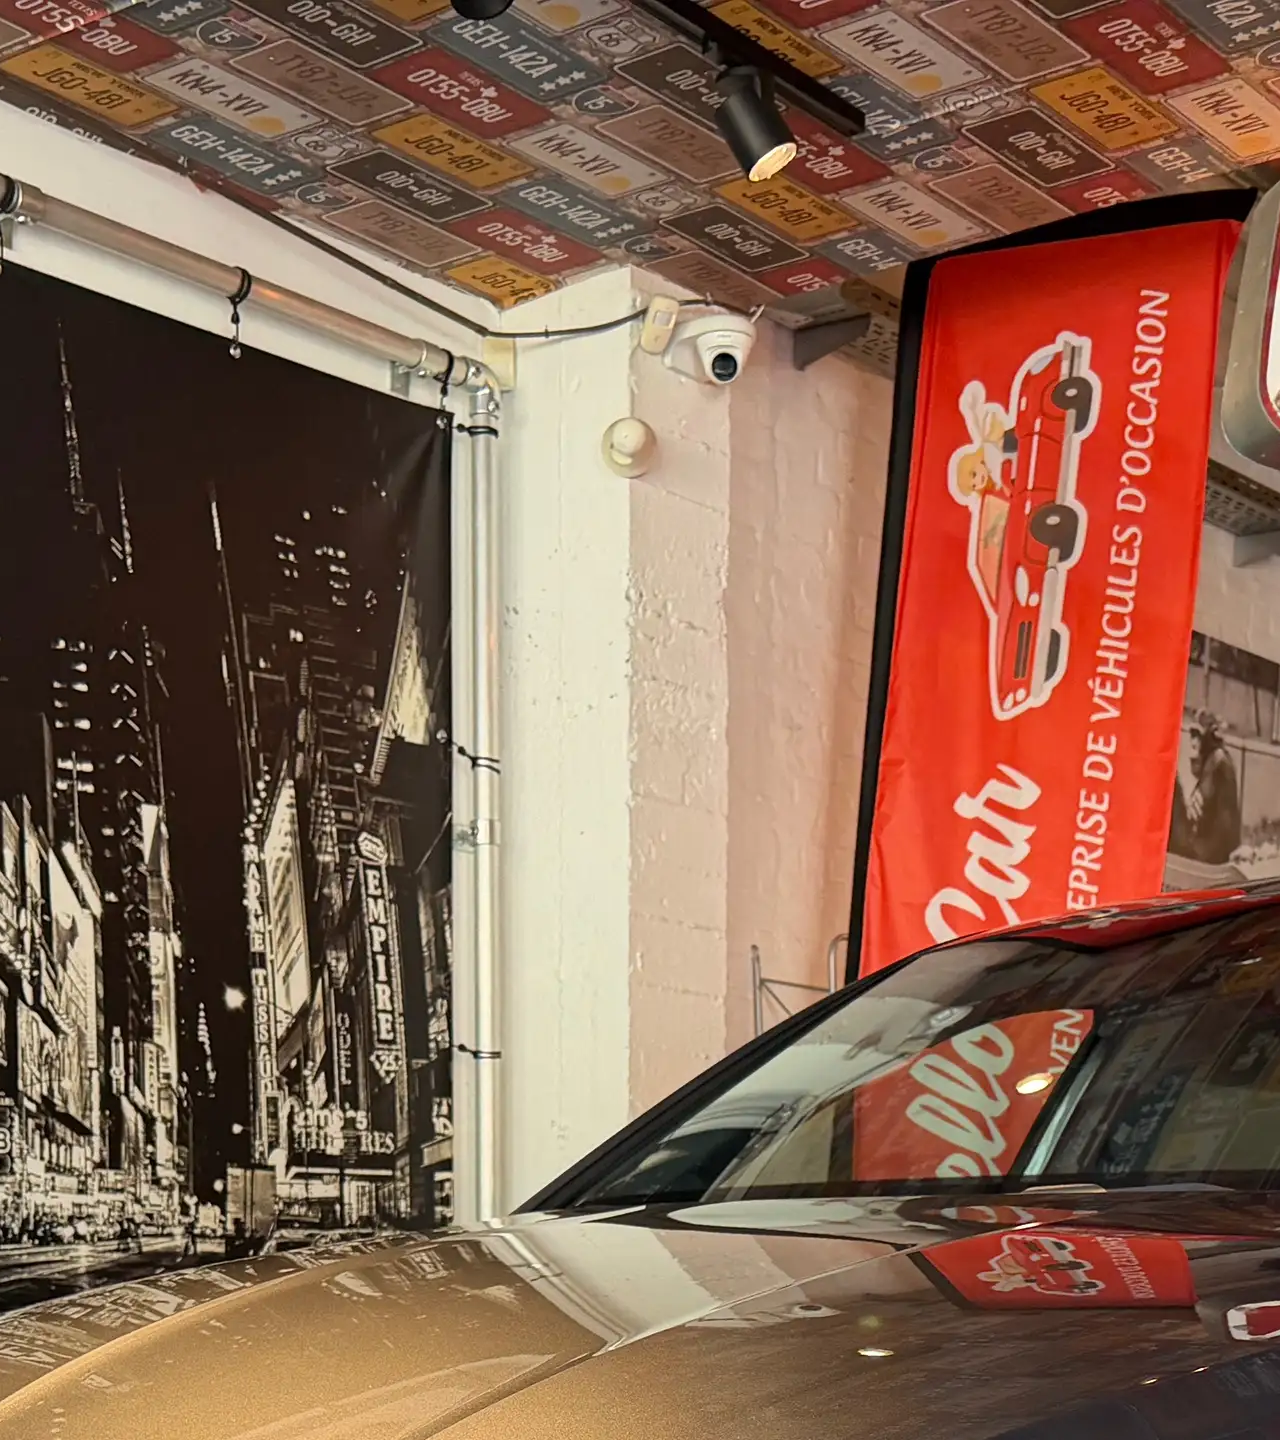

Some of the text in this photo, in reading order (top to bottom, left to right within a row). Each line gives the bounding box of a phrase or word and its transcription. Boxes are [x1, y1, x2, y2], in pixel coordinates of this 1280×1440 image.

[1067, 288, 1171, 912] EPRISE DE VÉHICULES D'OCCASION
[366, 868, 395, 1044] EMPIRE
